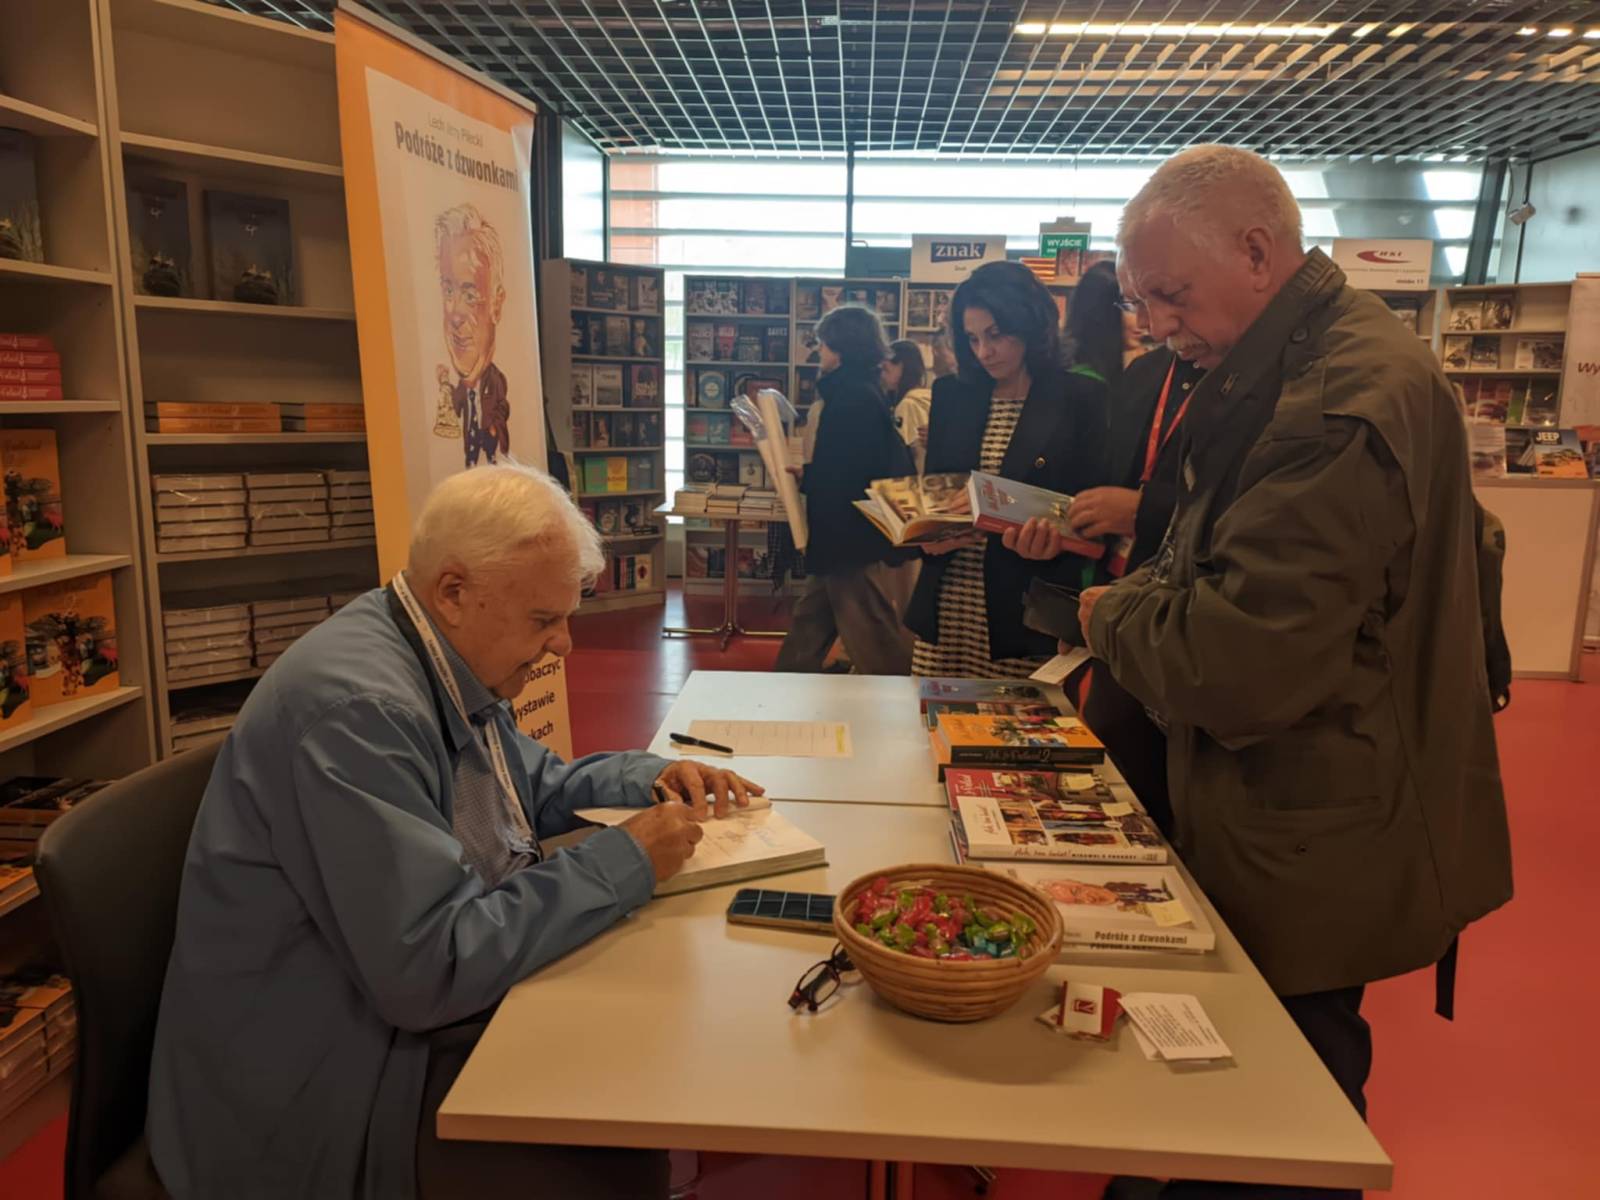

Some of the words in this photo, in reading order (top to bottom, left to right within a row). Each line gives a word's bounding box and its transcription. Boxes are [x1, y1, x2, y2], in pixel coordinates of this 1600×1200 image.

[394, 120, 445, 167] Podróże
[446, 148, 454, 171] z
[454, 148, 519, 192] dzwonkami
[935, 240, 981, 258] znak
[1047, 238, 1082, 247] WYJŚCIE
[1535, 431, 1560, 442] JEEP
[1094, 931, 1129, 942] Podróże
[1131, 933, 1136, 941] z
[1138, 932, 1188, 944] dzwonkami
